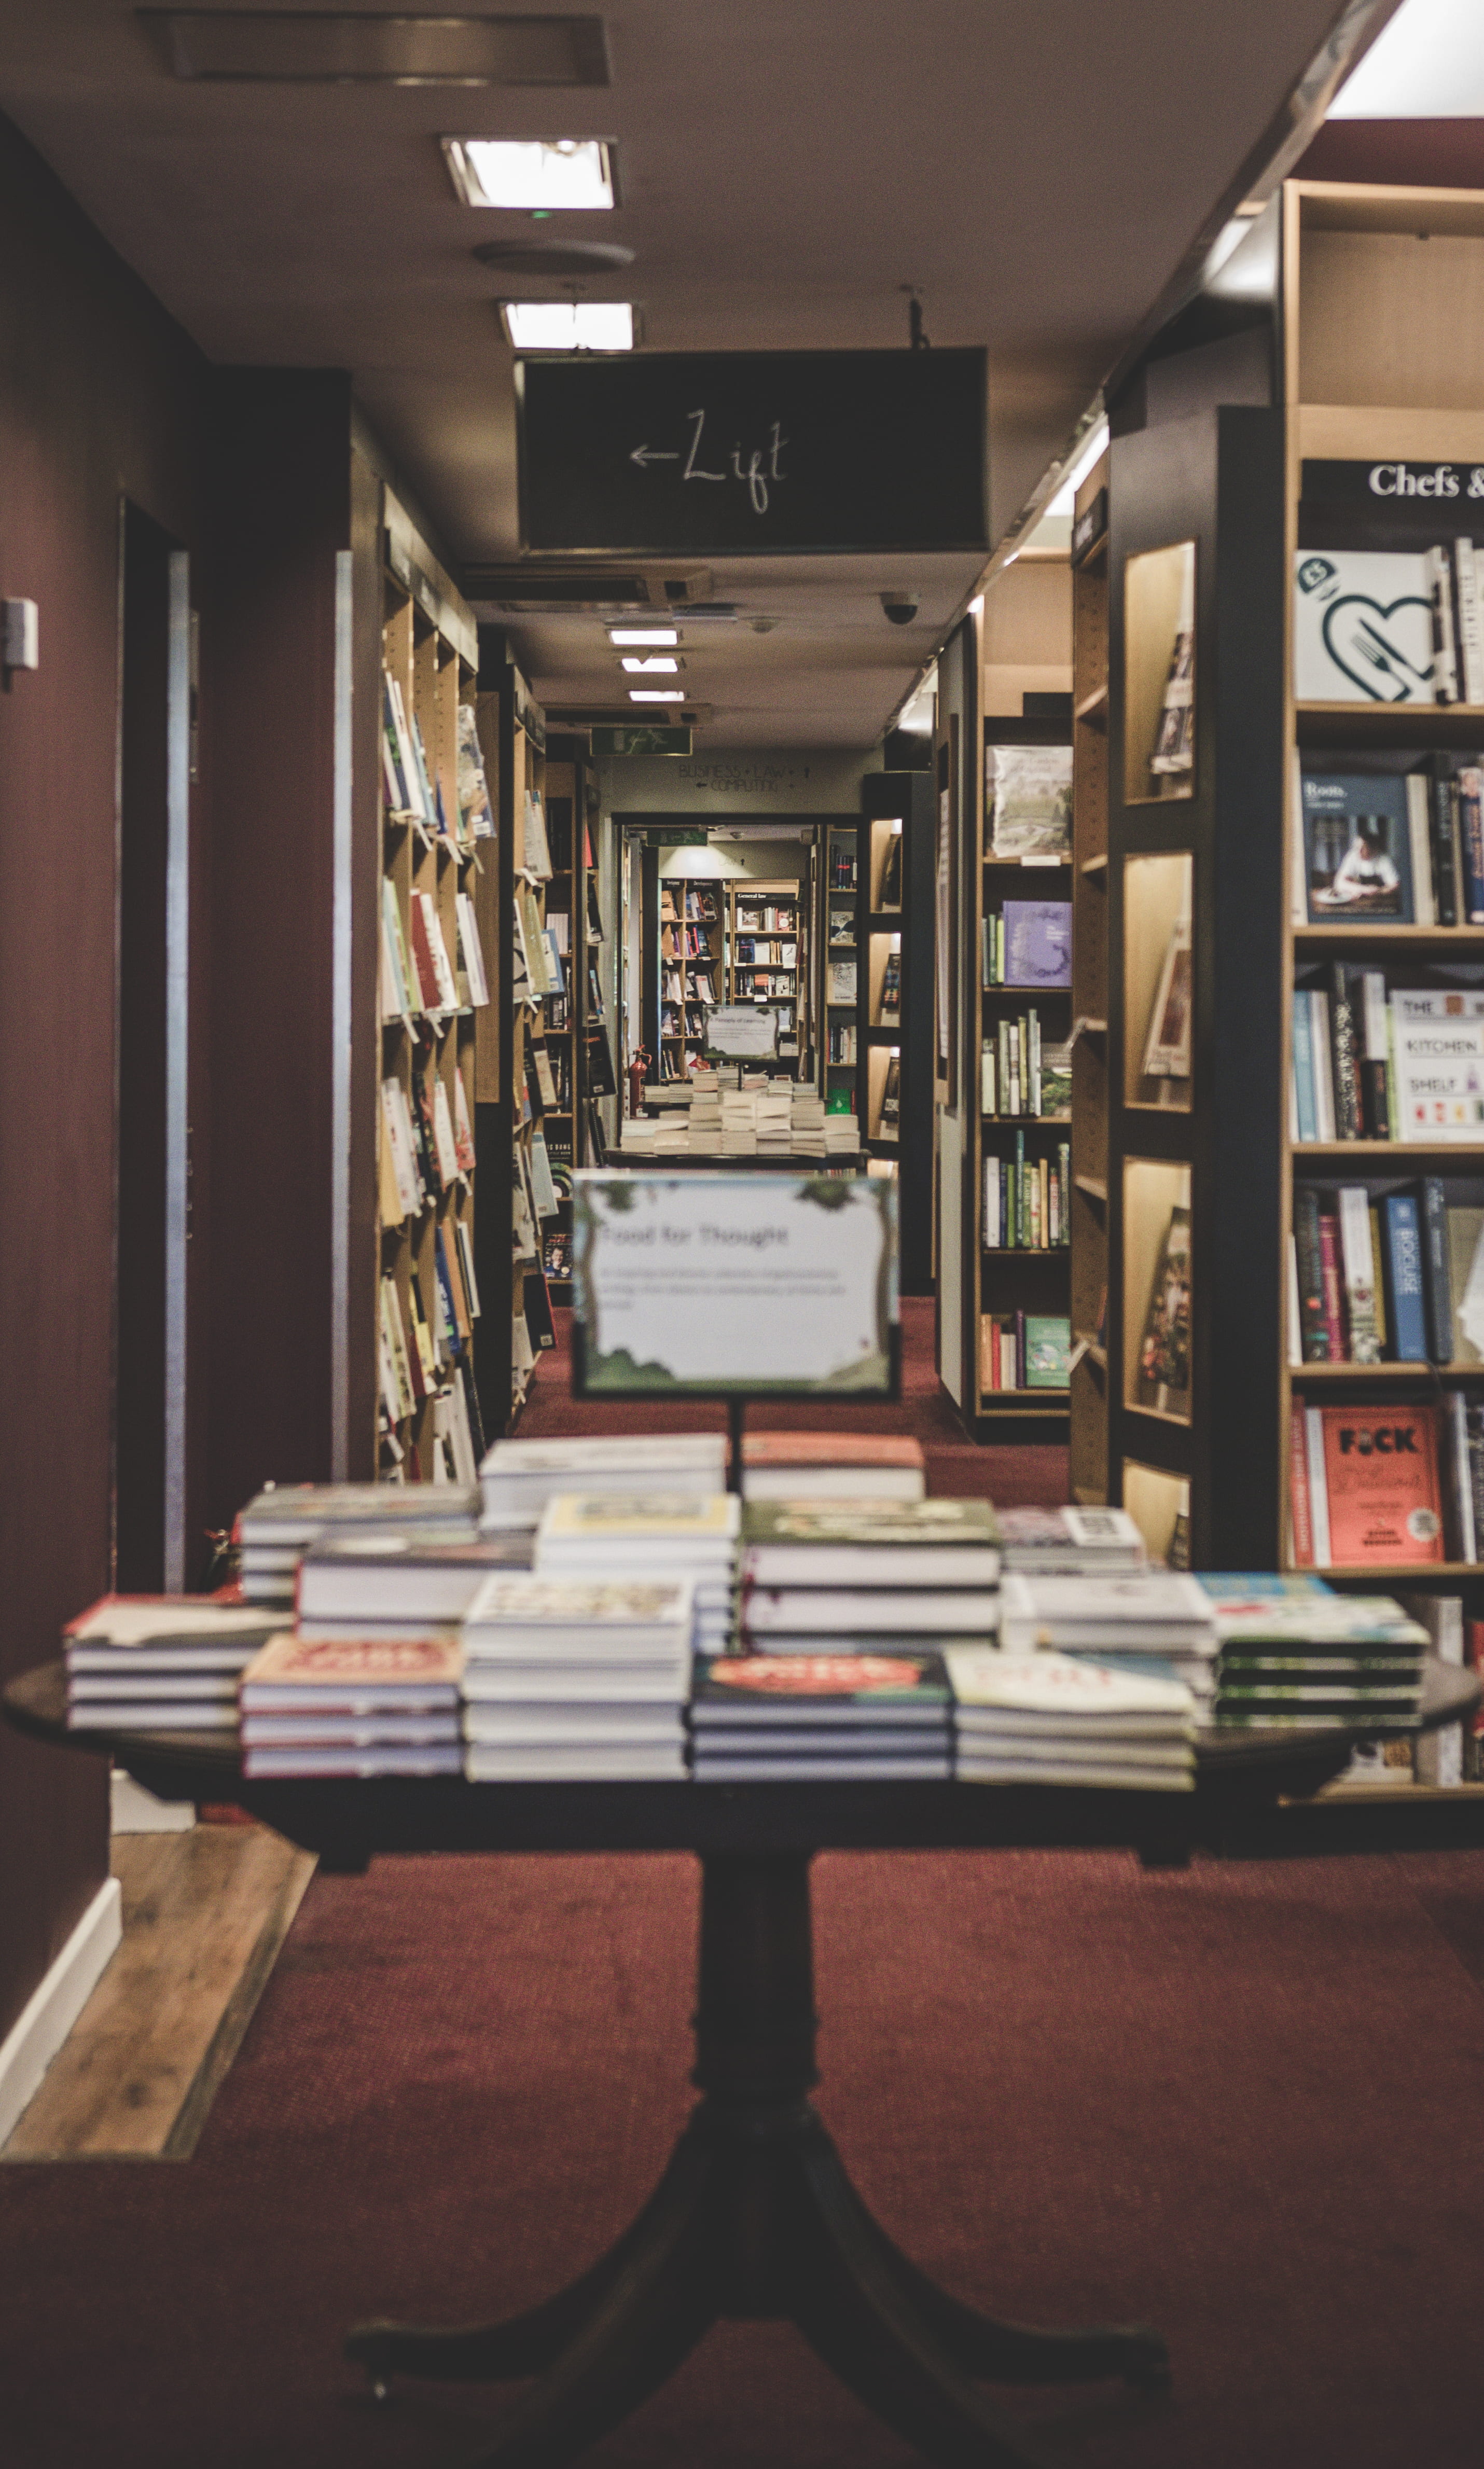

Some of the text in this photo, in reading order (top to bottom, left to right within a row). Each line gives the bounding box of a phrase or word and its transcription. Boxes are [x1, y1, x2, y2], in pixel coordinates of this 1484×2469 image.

[683, 408, 790, 515] Lift
[1368, 464, 1460, 497] Chefs
[1404, 1001, 1433, 1015] THE
[1407, 1040, 1477, 1053] KITCHEN
[1409, 1078, 1458, 1092] SHELF
[602, 1225, 789, 1251] Food for Thought
